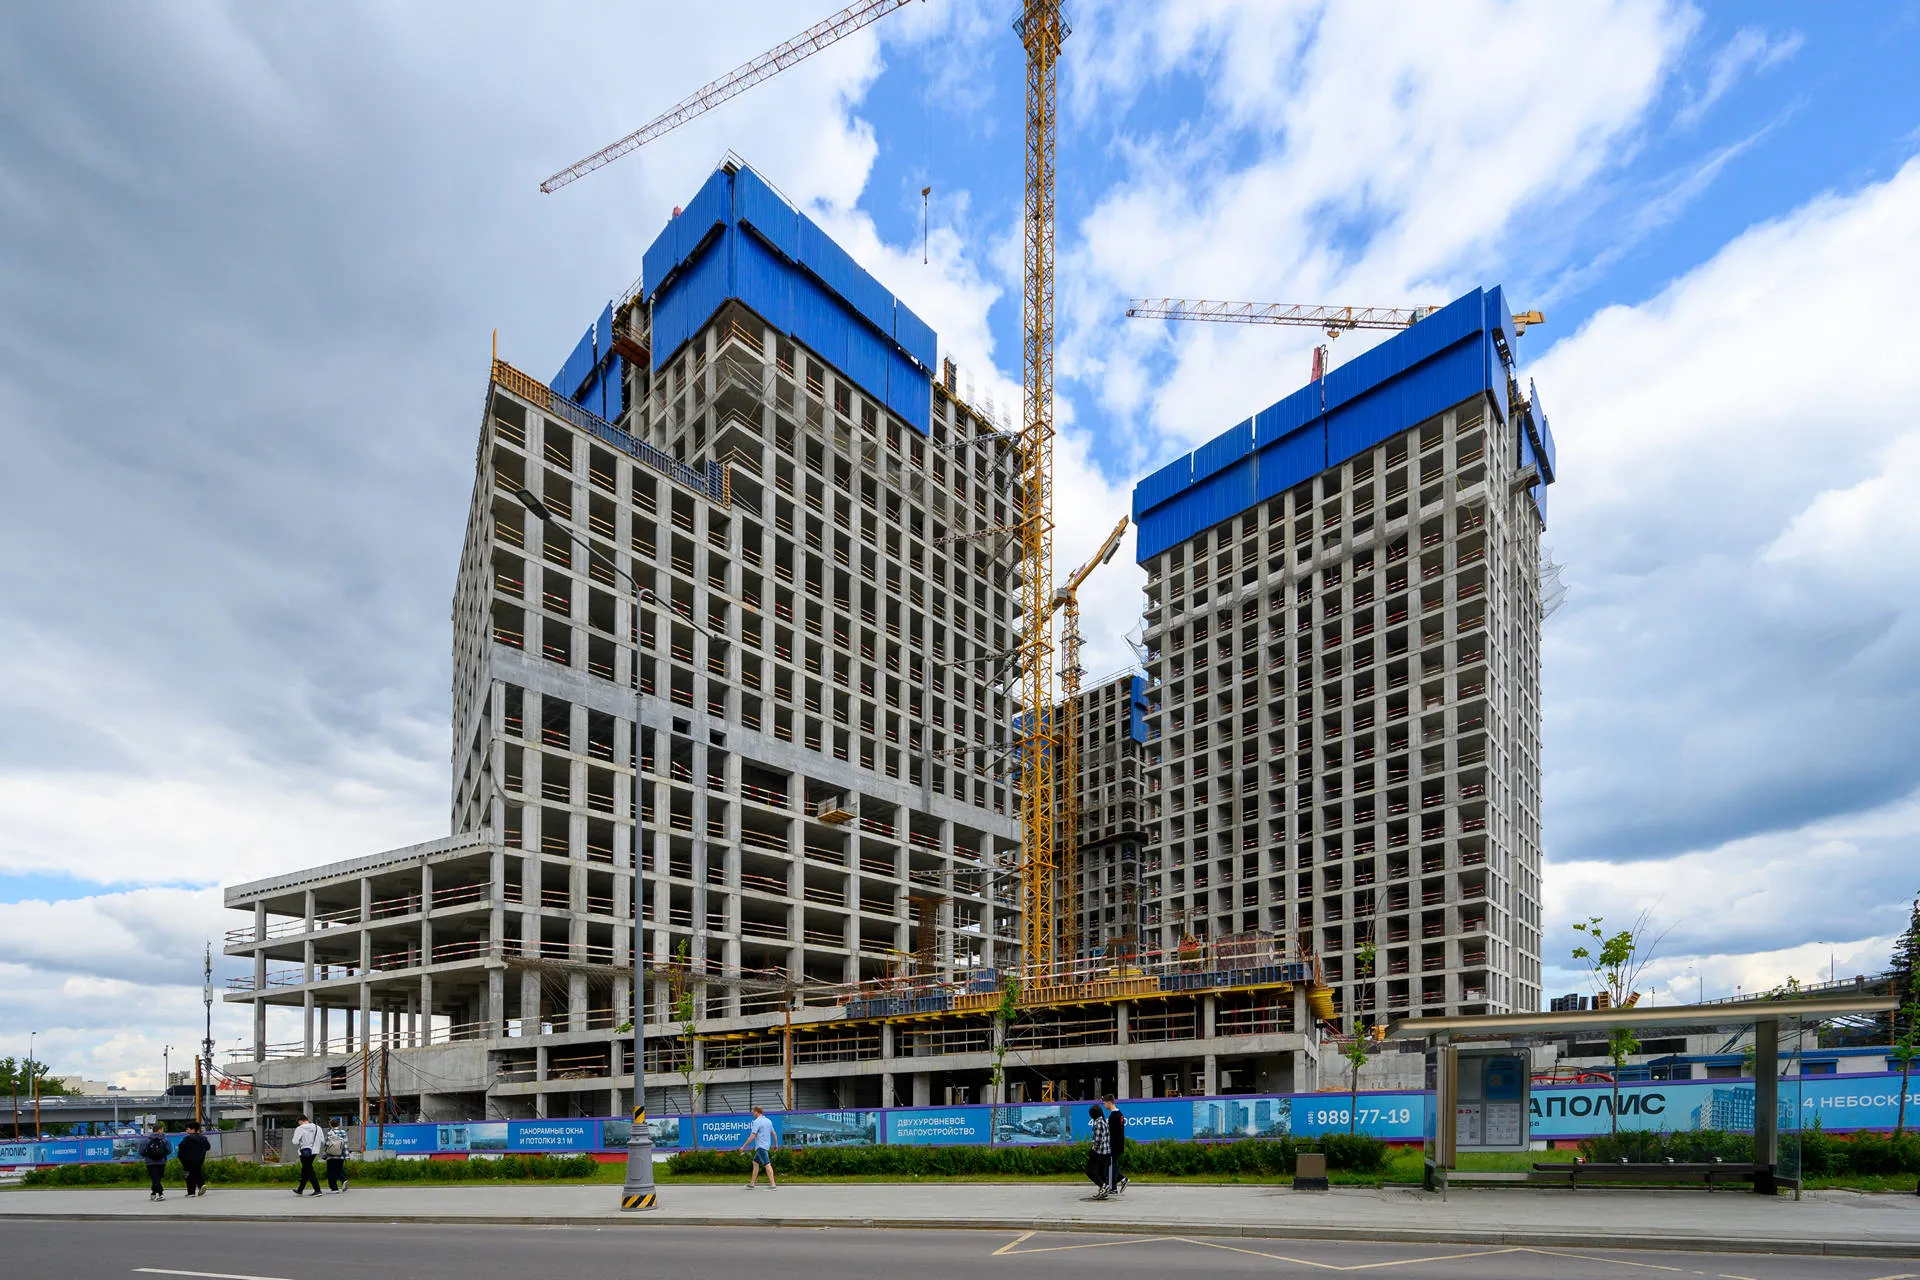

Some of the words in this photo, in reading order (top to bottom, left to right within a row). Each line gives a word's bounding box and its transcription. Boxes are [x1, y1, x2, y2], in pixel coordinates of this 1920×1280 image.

[1803, 1097, 1815, 1109] 4
[1820, 1093, 1920, 1109] НЕБОСКРЕ
[1317, 1108, 1411, 1125] 989-77-19
[897, 1117, 966, 1127] ДВУХУРОВНЕВОЕ
[1088, 1119, 1094, 1127] 4
[520, 1127, 564, 1135] ПАНОРАМНЫЕ
[565, 1127, 584, 1135] ОКНА
[897, 1127, 975, 1137] БЛАГОУСТРОЙСТВО
[525, 1137, 555, 1145] ПОТОЛКИ
[703, 1133, 740, 1142] ПАРКИНГ
